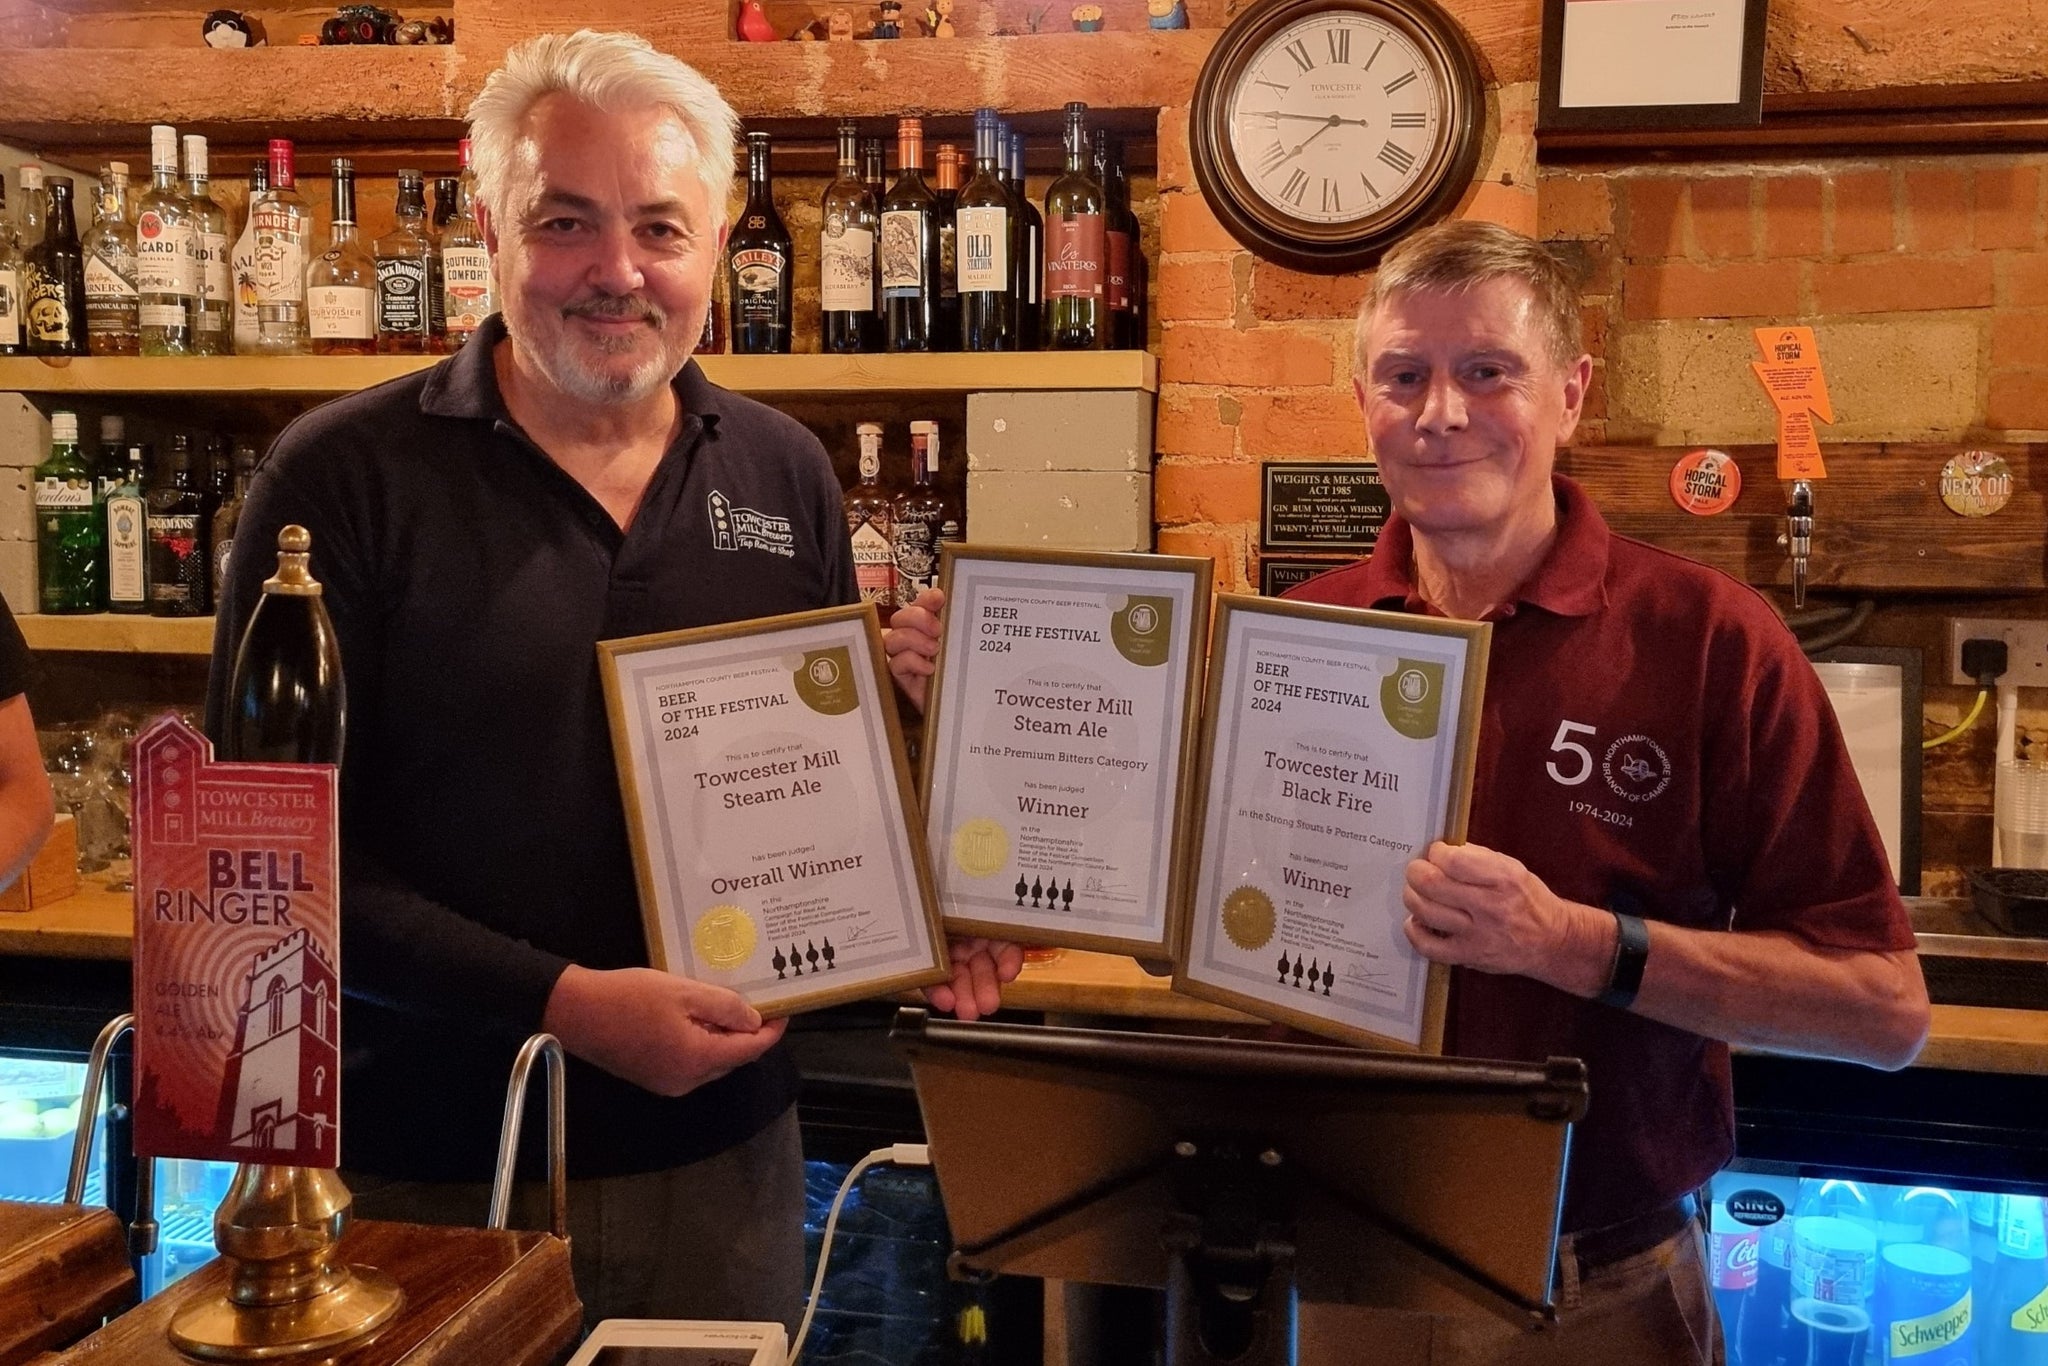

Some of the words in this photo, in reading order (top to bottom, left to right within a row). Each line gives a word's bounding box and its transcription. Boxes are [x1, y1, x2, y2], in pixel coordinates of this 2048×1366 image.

[1325, 29, 1352, 65] XII
[1284, 38, 1317, 77] XI
[1312, 84, 1362, 92] TOWCESTER
[1382, 69, 1418, 98] II
[1390, 112, 1426, 129] III
[1279, 167, 1311, 207] VII
[967, 234, 992, 258] OLD
[734, 252, 783, 267] BAILEYS
[967, 258, 992, 271] STATION
[377, 264, 395, 282] JACK
[395, 263, 424, 282] DANIEL'S
[448, 270, 488, 281] COMFORT
[310, 308, 362, 317] COURVOISIER
[1774, 343, 1802, 352] HOPICAL
[1776, 351, 1800, 360] STORM
[1274, 475, 1321, 484] WEIGHTS
[1322, 475, 1331, 484] &
[1333, 476, 1383, 485] MEASURE
[1684, 468, 1728, 488] HOPICAL
[1942, 476, 1982, 496] NECK
[1988, 477, 2010, 496] OIL
[1309, 487, 1330, 495] ACT
[1332, 486, 1352, 495] 1985
[1684, 482, 1722, 499] STORM
[1316, 505, 1345, 513] VODKA
[1350, 505, 1384, 513] WHISKY
[732, 513, 792, 533] TOWCESTER
[1274, 524, 1331, 532] TWENTY-FIVE
[1332, 525, 1383, 534] MILLILITRE
[736, 523, 762, 535] MILL
[761, 528, 793, 544] Brewery
[738, 538, 753, 550] Tap
[778, 547, 795, 558] Shop
[1274, 570, 1306, 581] WINE
[984, 596, 1030, 604] NORTHAMPTON
[1030, 598, 1056, 606] COUNTY
[1056, 600, 1072, 608] BEER
[1072, 601, 1102, 609] FESTIVAL
[983, 606, 1018, 620] BEER
[981, 623, 1000, 635] OF
[1003, 625, 1032, 638] THE
[1035, 627, 1101, 643] FESTIVAL
[979, 640, 1012, 653] 2024
[1255, 662, 1290, 678] BEER
[1256, 650, 1301, 662] NORTHAMPTON
[1301, 656, 1325, 665] COUNTY
[1326, 659, 1342, 668] BEER
[1343, 662, 1371, 672] FESTIVAL
[656, 678, 705, 692] NORTHAMPTON
[706, 675, 732, 683] COUNTY
[733, 671, 750, 680] BEER
[751, 667, 780, 677] FESTIVAL
[1028, 679, 1042, 687] This
[1061, 682, 1085, 692] certify
[1087, 684, 1102, 692] that
[658, 691, 698, 708] BEER
[994, 689, 1092, 712] Towcester
[1096, 698, 1133, 716] Mill
[1254, 679, 1272, 692] OF
[1275, 683, 1303, 698] THE
[1304, 687, 1370, 709] FESTIVAL
[661, 711, 682, 724] OF
[684, 704, 717, 721] THE
[720, 693, 789, 715] FESTIVAL
[1251, 697, 1282, 713] 2024
[664, 725, 700, 742] 2024
[1014, 715, 1072, 736] Steam
[1077, 721, 1108, 739] Ale
[726, 754, 742, 763] This
[743, 752, 750, 760] is
[761, 746, 786, 758] certify
[787, 743, 803, 752] that
[970, 745, 981, 754] in
[984, 745, 1002, 756] the
[1003, 747, 1055, 762] Premium
[1058, 752, 1094, 765] Bitters
[1096, 756, 1149, 772] Category
[1296, 742, 1310, 752] This
[1319, 746, 1327, 755] to
[1329, 748, 1352, 760] certify
[1354, 752, 1369, 762] that
[1604, 734, 1671, 776] NORTHAMPTONSHIRE
[694, 760, 798, 790] Towcester
[802, 750, 841, 771] Mill
[1264, 751, 1358, 784] Towcester
[1362, 770, 1399, 792] Mill
[1024, 781, 1038, 790] has
[1039, 783, 1058, 791] been
[1058, 784, 1085, 794] judged
[1602, 763, 1628, 798] BRANCH
[1629, 794, 1640, 802] OF
[1642, 777, 1671, 802] CAMRA
[196, 790, 318, 810] TOWCESTER
[723, 786, 787, 809] Steam
[790, 779, 822, 798] Ale
[1282, 780, 1332, 806] Black
[1336, 791, 1373, 814] Fire
[1017, 796, 1089, 819] Winner
[1569, 800, 1634, 828] 1974-2024
[201, 810, 248, 826] MILL
[250, 812, 317, 834] Brewery
[1239, 808, 1248, 817] in
[1250, 810, 1264, 820] the
[1265, 813, 1294, 829] Strong
[1296, 820, 1325, 834] Stouts
[1326, 826, 1333, 835] &
[1335, 827, 1367, 843] Porters
[1370, 835, 1413, 853] Category
[752, 853, 768, 863] has
[769, 849, 787, 860] been
[788, 844, 816, 858] judged
[1289, 853, 1302, 862] has
[1304, 855, 1321, 864] been
[1322, 857, 1349, 872] judged
[208, 849, 315, 893] BELL
[711, 867, 785, 896] Overall
[788, 854, 864, 881] Winner
[1283, 867, 1352, 899] Winner
[155, 890, 292, 927] RINGER
[155, 982, 220, 998] GOLDEN
[156, 1004, 181, 1017] ALE
[1734, 1212, 1778, 1221] REFRIGERATION
